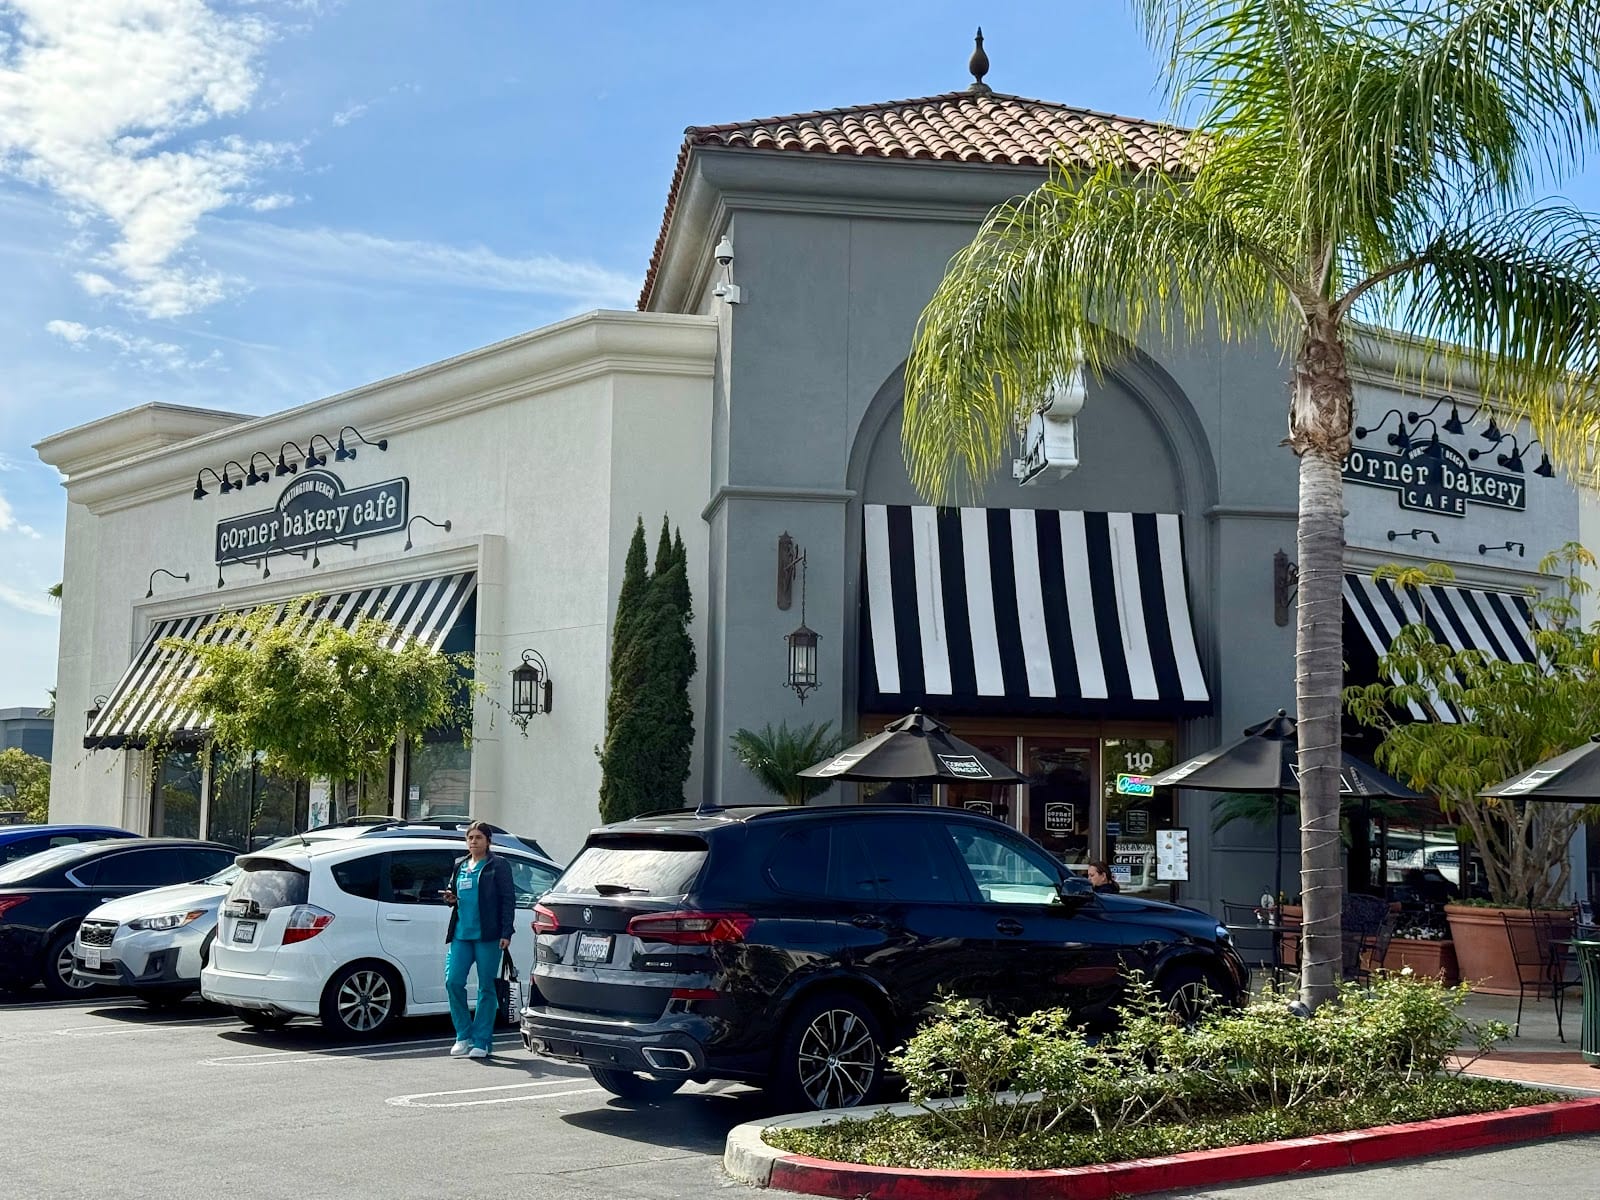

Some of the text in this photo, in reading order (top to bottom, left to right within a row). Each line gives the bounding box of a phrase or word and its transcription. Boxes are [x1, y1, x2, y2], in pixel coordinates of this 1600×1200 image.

[280, 480, 335, 511] HUNTINGTON BEACH
[1441, 465, 1522, 506] bakery
[1408, 491, 1463, 512] CAFE
[220, 491, 397, 552] corner bakery cafe
[1119, 776, 1152, 793] Open
